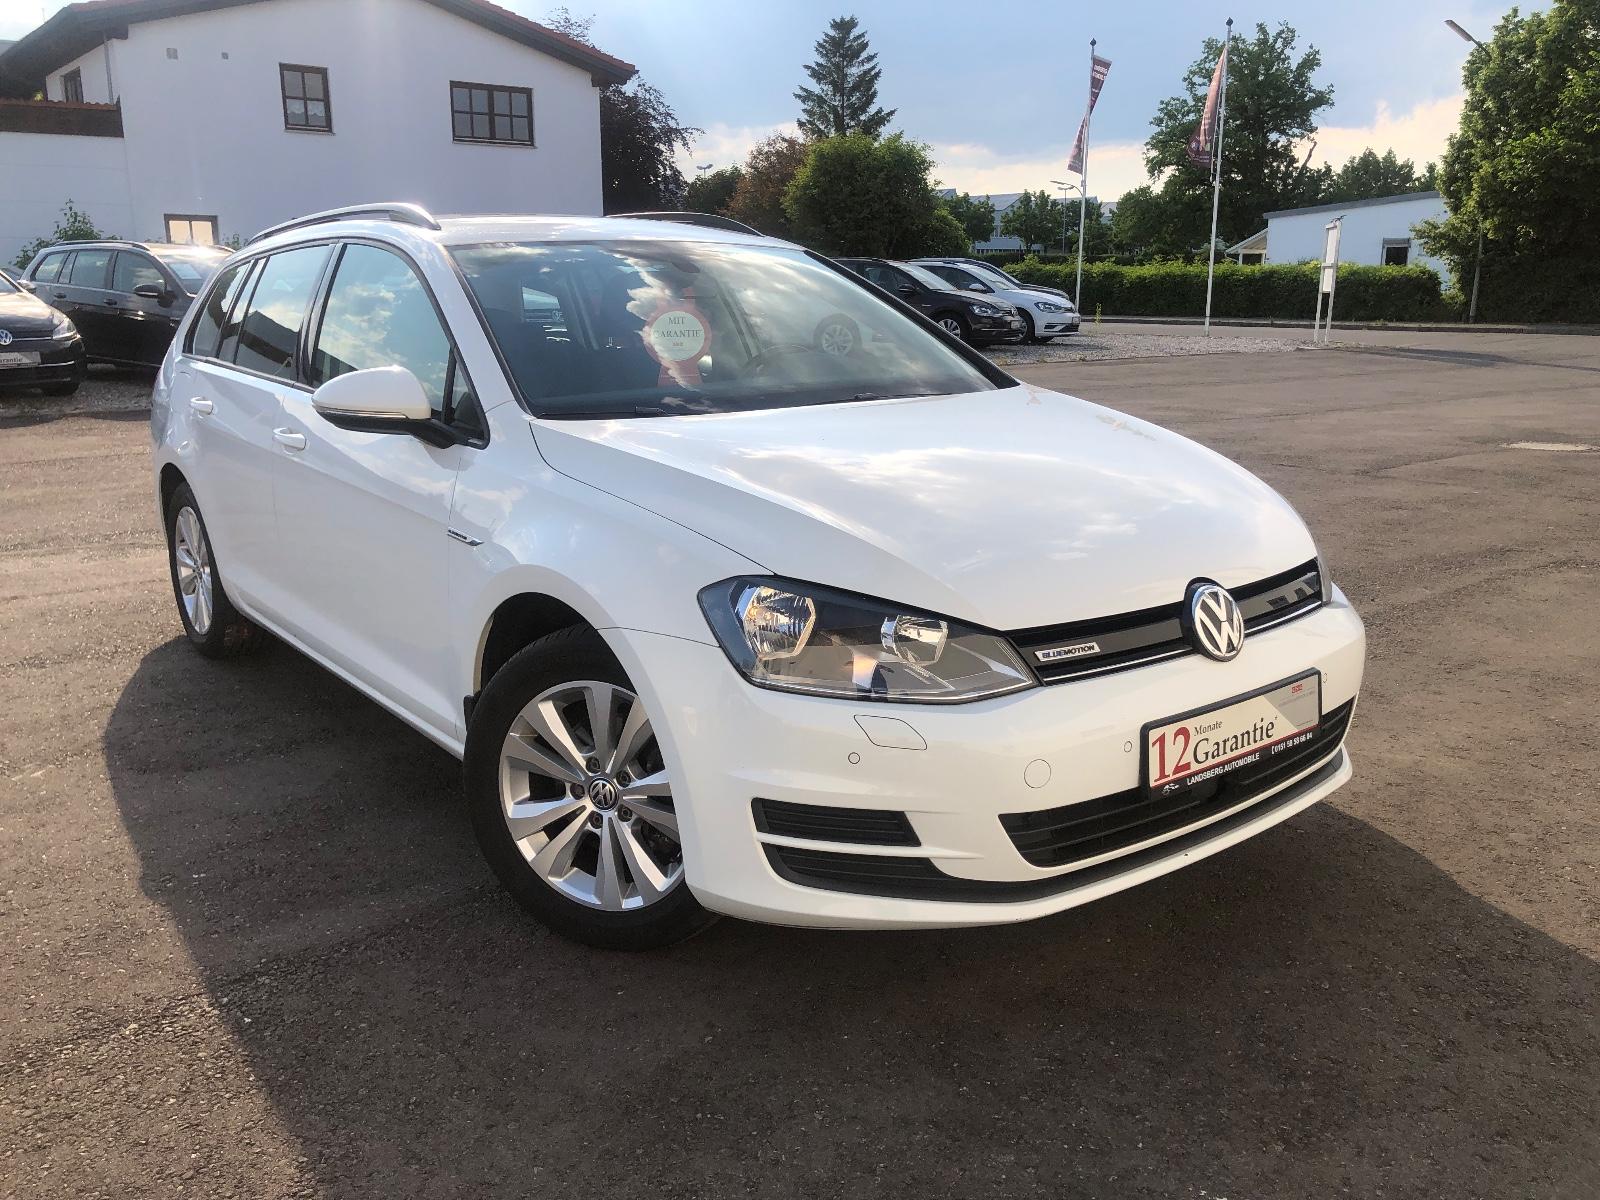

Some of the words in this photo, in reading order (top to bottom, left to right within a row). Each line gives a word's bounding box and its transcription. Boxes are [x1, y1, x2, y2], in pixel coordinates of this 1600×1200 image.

[668, 317, 686, 325] MIT
[1041, 645, 1095, 658] BLUEMOTION
[1193, 721, 1223, 737] Monate
[1151, 726, 1191, 782] 12
[1193, 717, 1275, 764] Garantie
[1187, 766, 1223, 785] LANDSBERG
[1223, 752, 1260, 773] AUTOMOBILE
